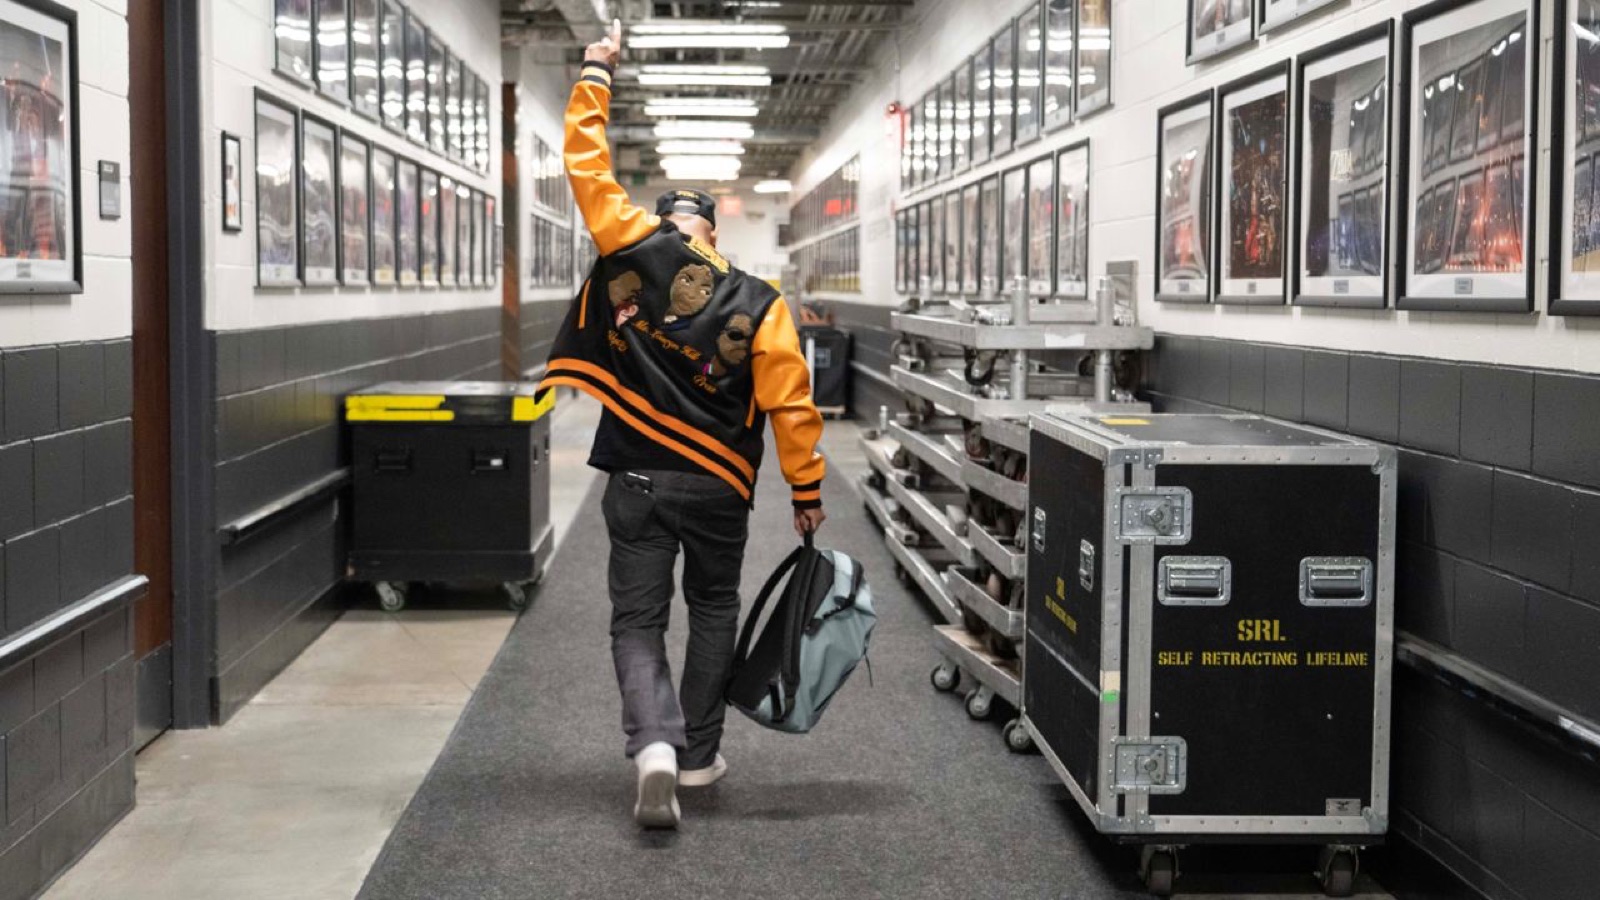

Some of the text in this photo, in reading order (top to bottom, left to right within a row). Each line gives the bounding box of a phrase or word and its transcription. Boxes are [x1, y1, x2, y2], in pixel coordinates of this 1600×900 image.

[1237, 619, 1286, 641] SRL
[1158, 651, 1368, 667] SELF RETRACTING LIFELINE
